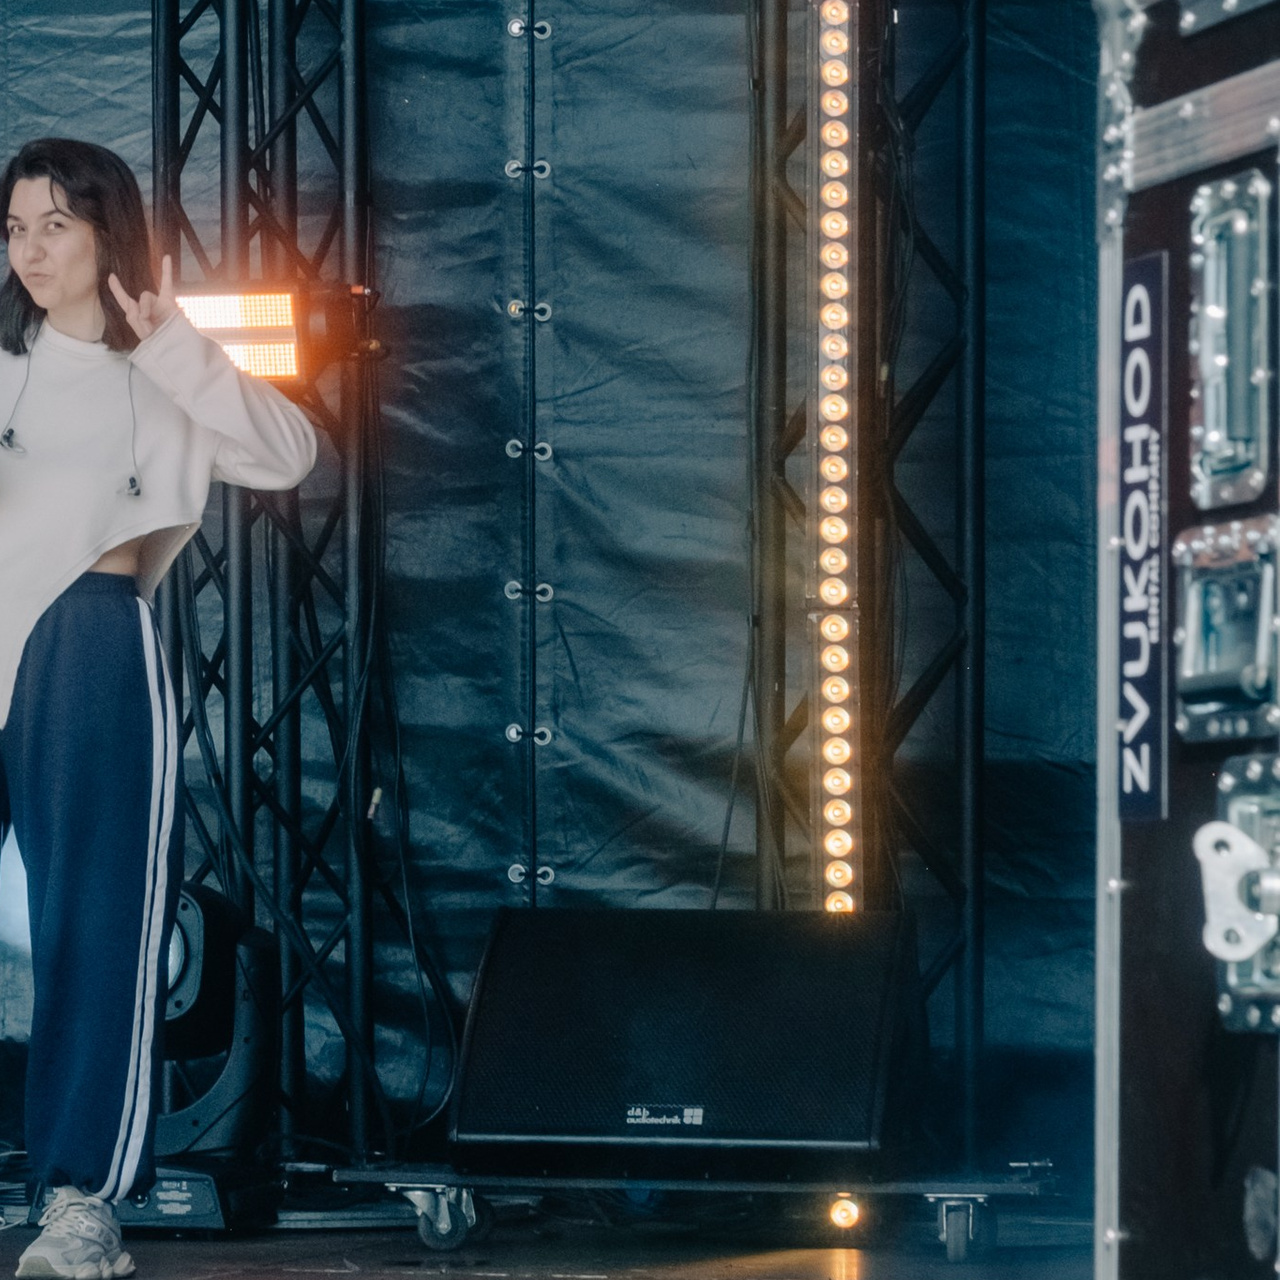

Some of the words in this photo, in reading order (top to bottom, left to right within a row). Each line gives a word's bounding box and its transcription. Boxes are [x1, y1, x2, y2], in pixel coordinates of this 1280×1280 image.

[1148, 428, 1160, 549] COMPANY
[1123, 283, 1151, 794] ZVUKOHOD
[1148, 553, 1160, 644] RENTAL
[626, 1114, 681, 1124] audiotechnik
[627, 1106, 650, 1118] d&b
